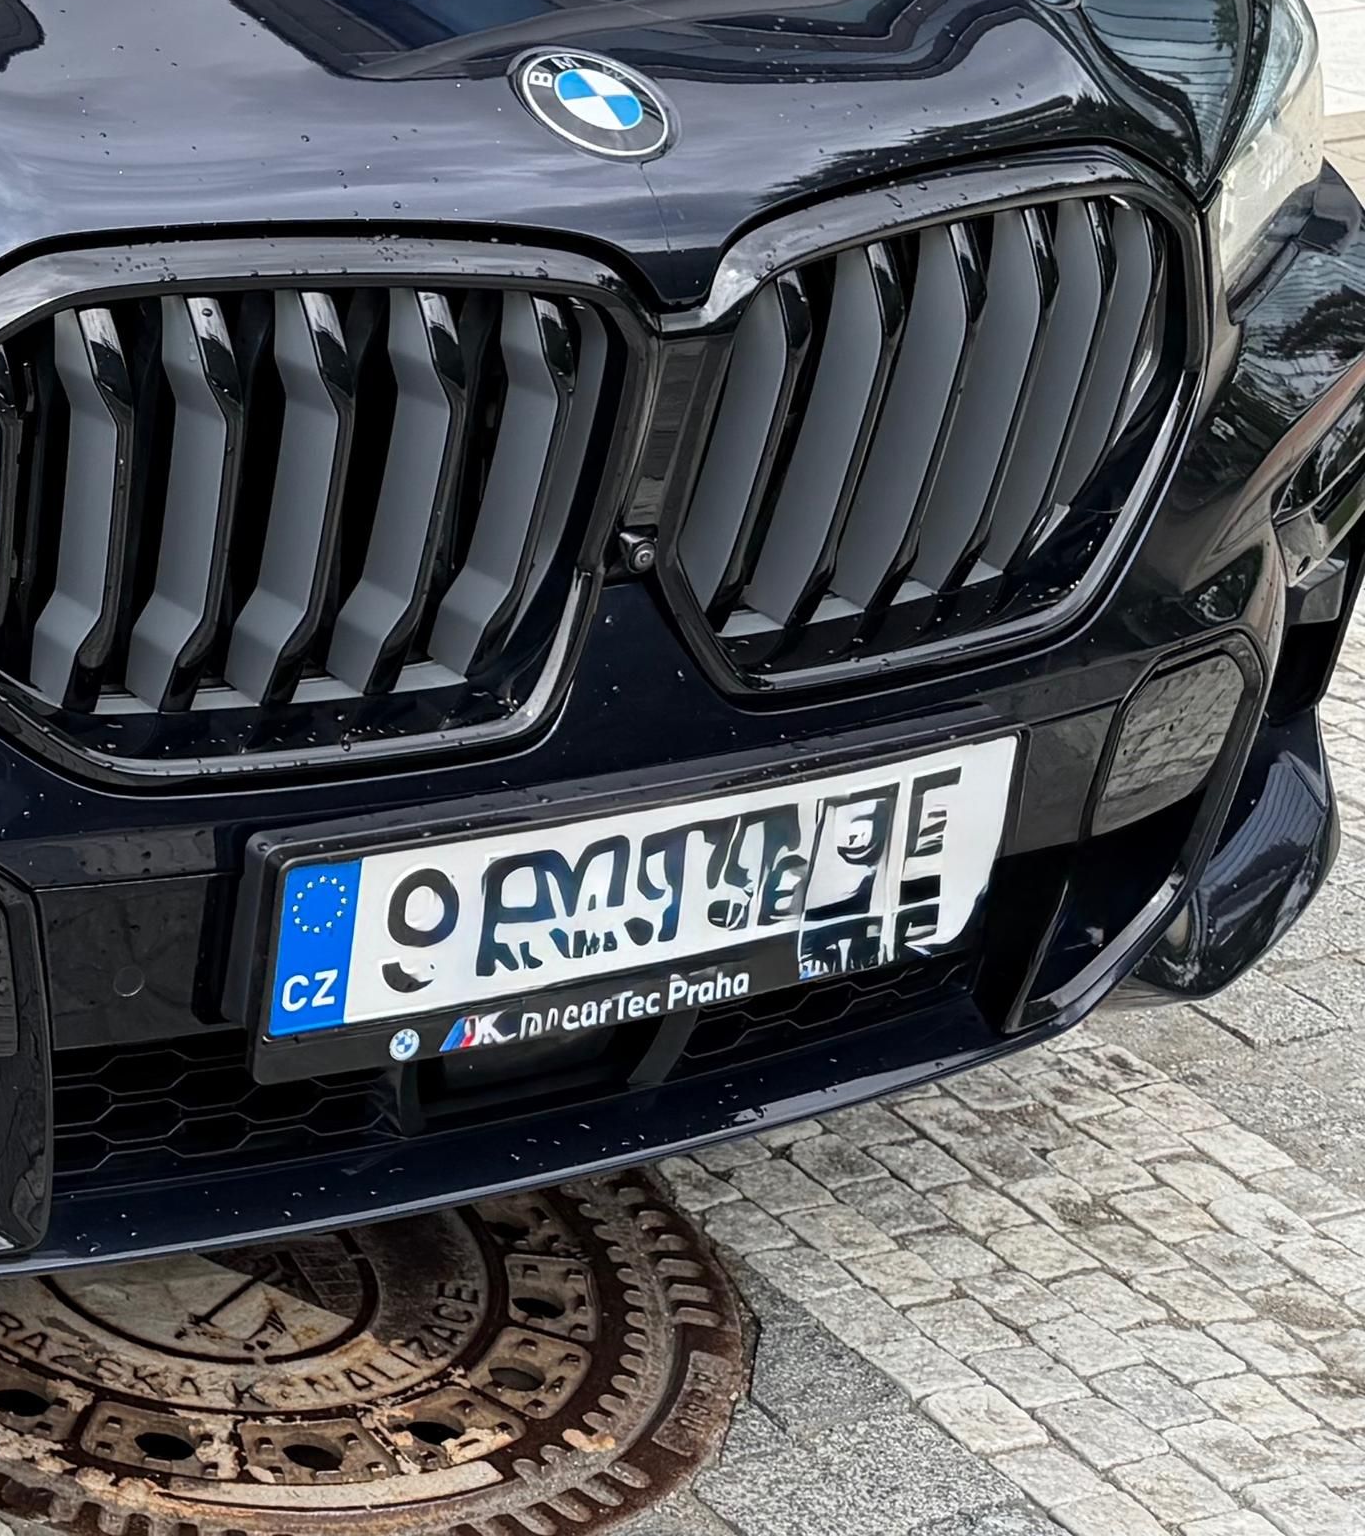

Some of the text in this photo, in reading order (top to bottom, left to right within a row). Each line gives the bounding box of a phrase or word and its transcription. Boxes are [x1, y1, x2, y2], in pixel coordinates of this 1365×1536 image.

[529, 56, 626, 88] BMW
[282, 968, 338, 1012] CZ
[667, 972, 750, 1010] Praha
